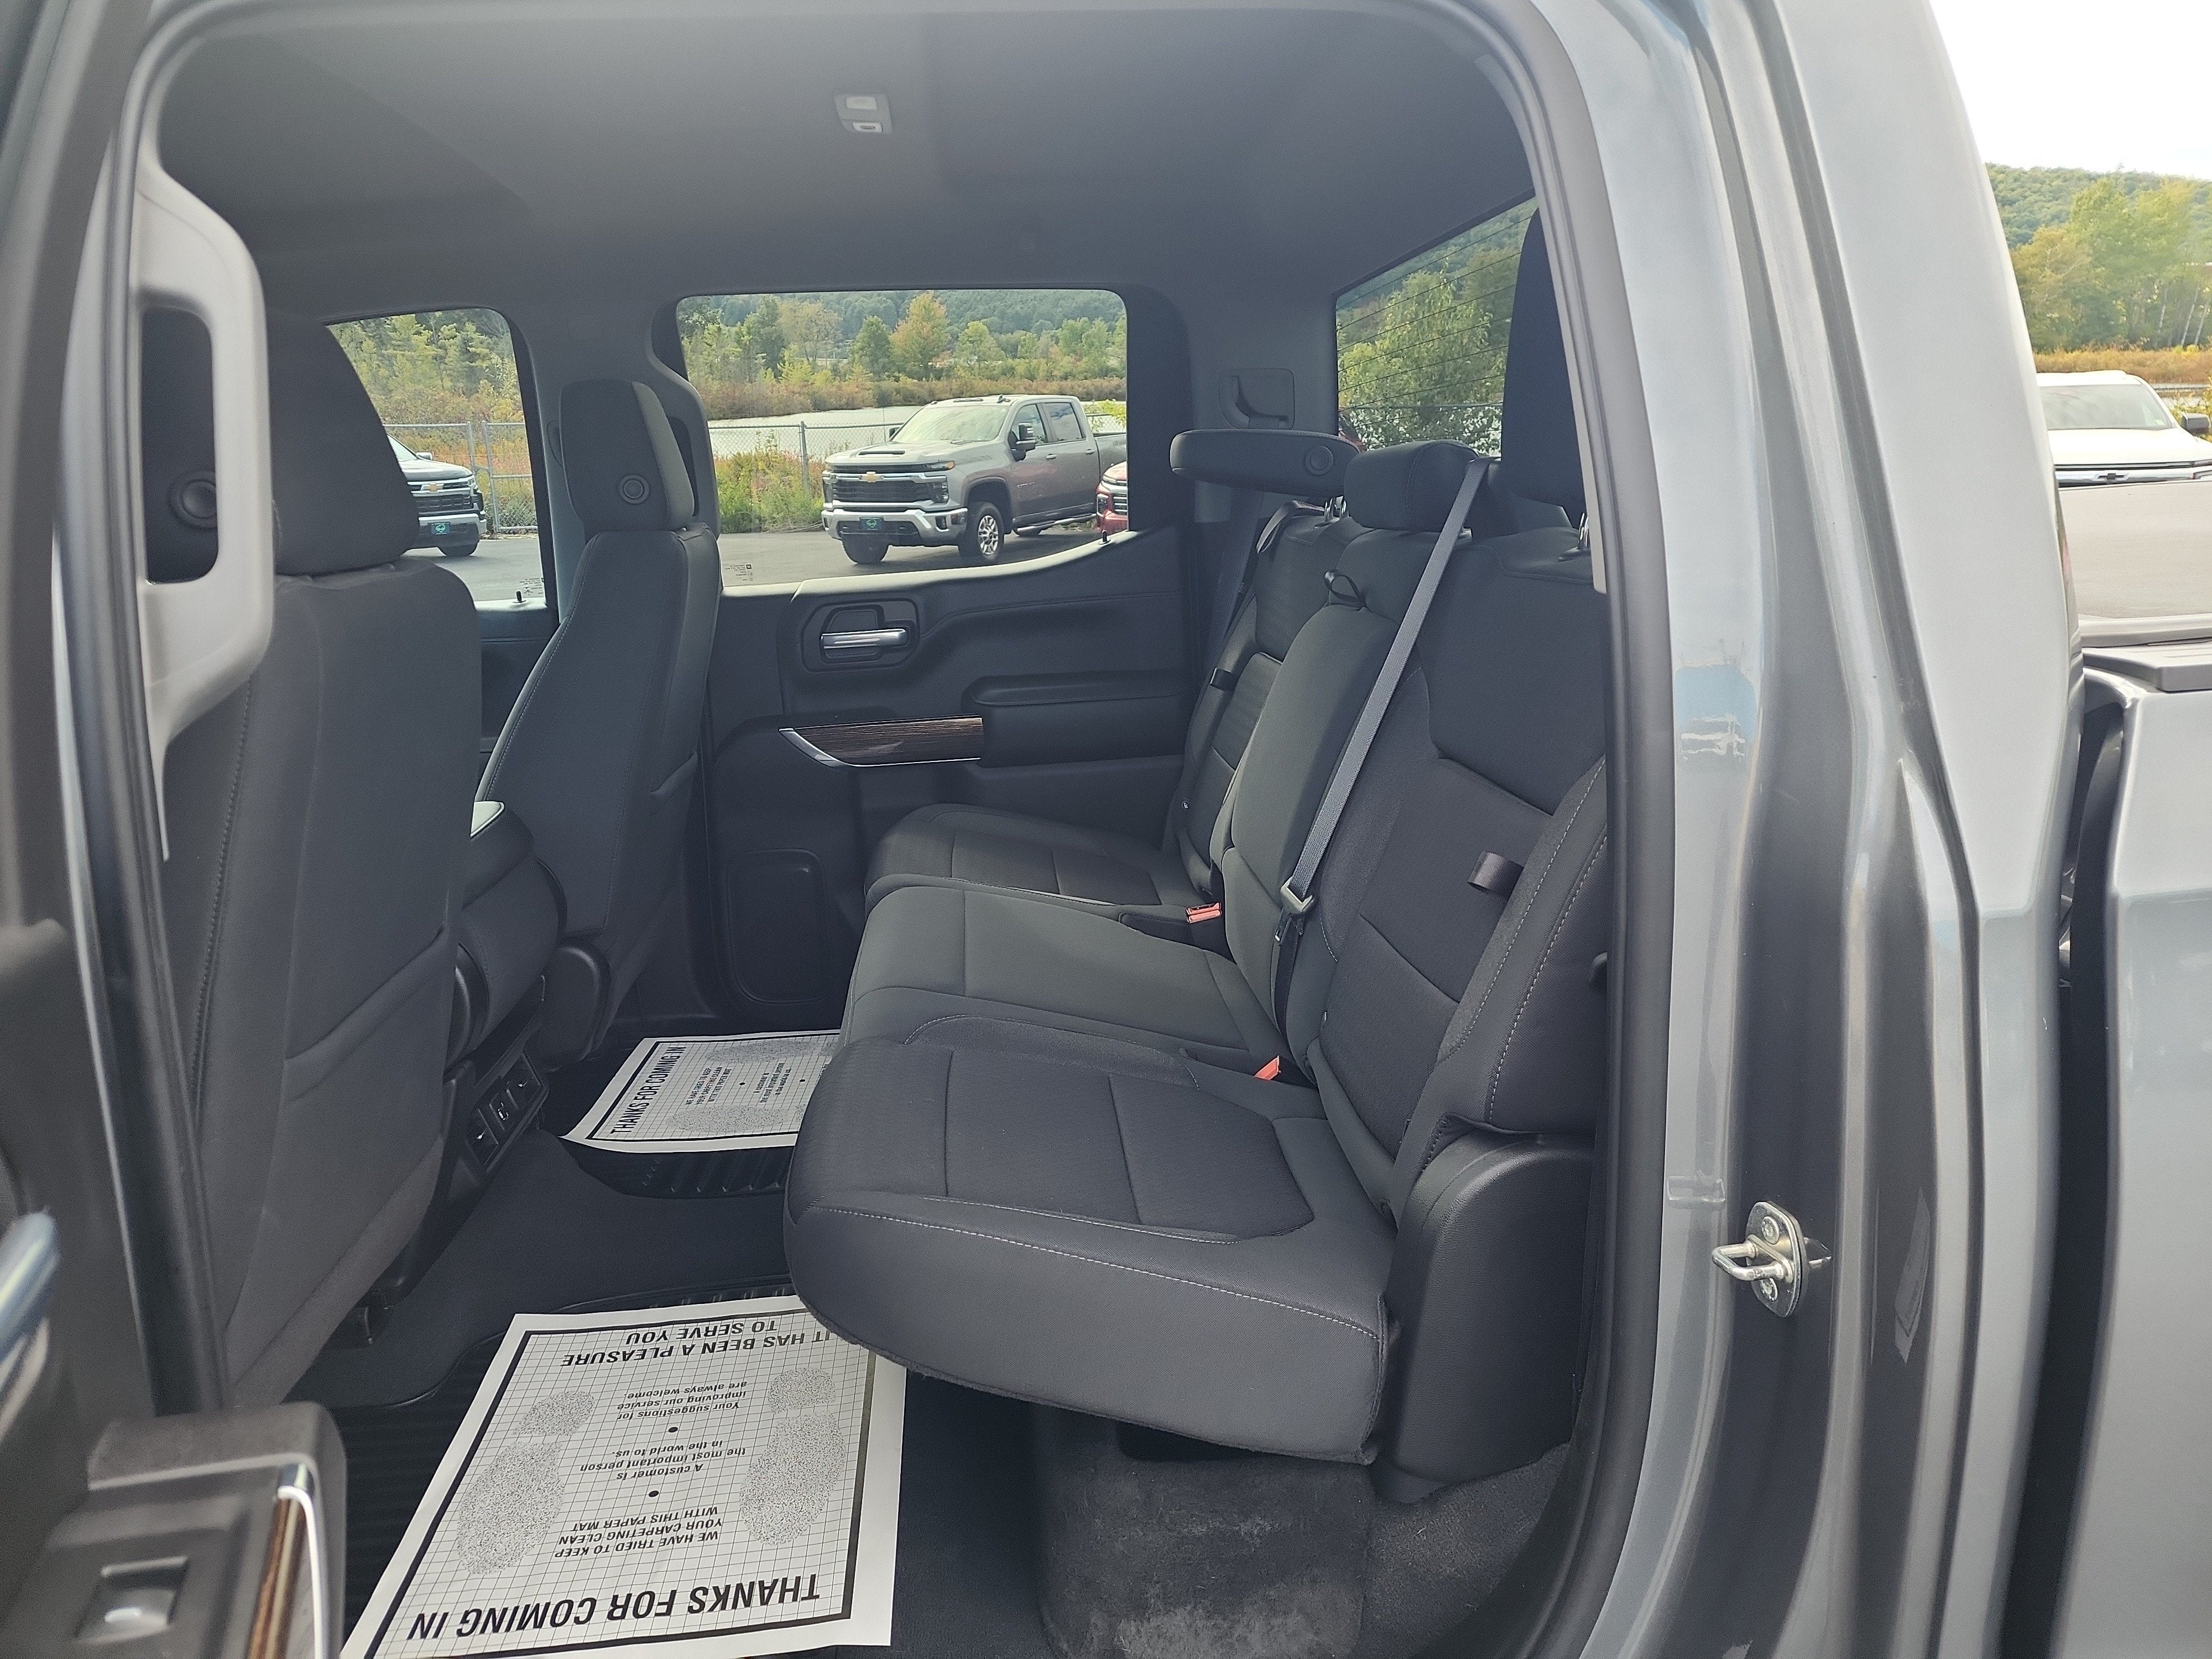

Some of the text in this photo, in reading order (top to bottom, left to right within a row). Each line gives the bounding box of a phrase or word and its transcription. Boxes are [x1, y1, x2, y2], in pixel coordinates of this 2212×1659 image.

[645, 1056, 680, 1083] COMING
[633, 1086, 661, 1100] FOR
[609, 1103, 650, 1134] THANKS
[626, 1320, 777, 1344] TO SERVE YOU
[560, 1331, 830, 1366] IT HAS BEEN A PLEASURE
[624, 1387, 680, 1399] welcome.
[684, 1383, 725, 1393] always
[617, 1391, 746, 1410] improving our service
[618, 1401, 739, 1420] Your suggestions for
[649, 1444, 684, 1454] world
[688, 1442, 708, 1450] the
[692, 1450, 723, 1461] most
[580, 1460, 623, 1472] person
[627, 1454, 688, 1468] important
[617, 1463, 703, 1480] A customer is
[571, 1506, 718, 1531] WITH THIS PAPER MAT
[559, 1518, 722, 1545] YOUR CARPETING CLEAN
[555, 1531, 718, 1558] WE HAVE TRIED TO KEEP
[407, 1573, 821, 1640] THANKS FOR COMING IN
